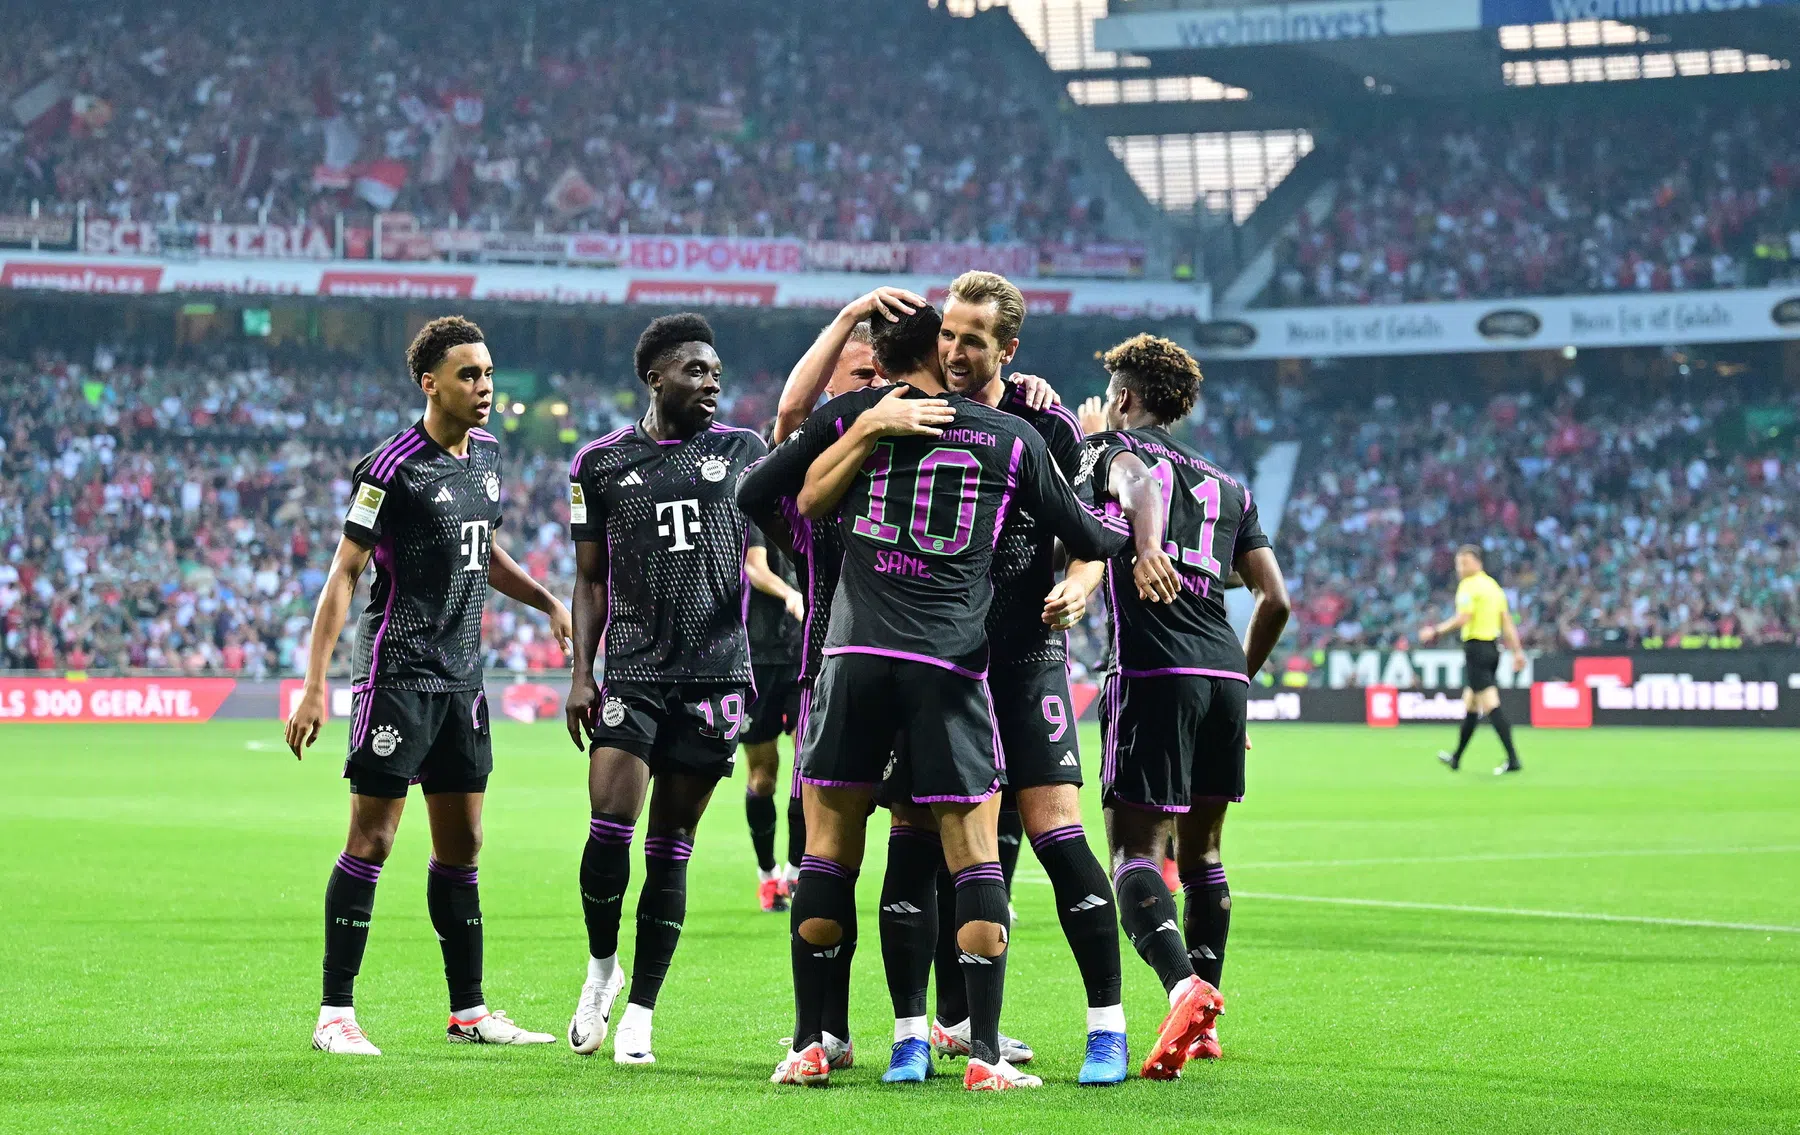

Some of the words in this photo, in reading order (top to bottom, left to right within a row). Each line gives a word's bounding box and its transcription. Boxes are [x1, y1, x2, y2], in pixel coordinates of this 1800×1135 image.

[1176, 4, 1387, 50] wohninvest
[684, 238, 802, 272] POWER
[939, 428, 996, 447] ÜNCHEN
[852, 441, 983, 556] 10
[32, 688, 83, 717] 300
[696, 693, 743, 740] 19
[1041, 695, 1068, 742] 9
[336, 917, 348, 926] FC
